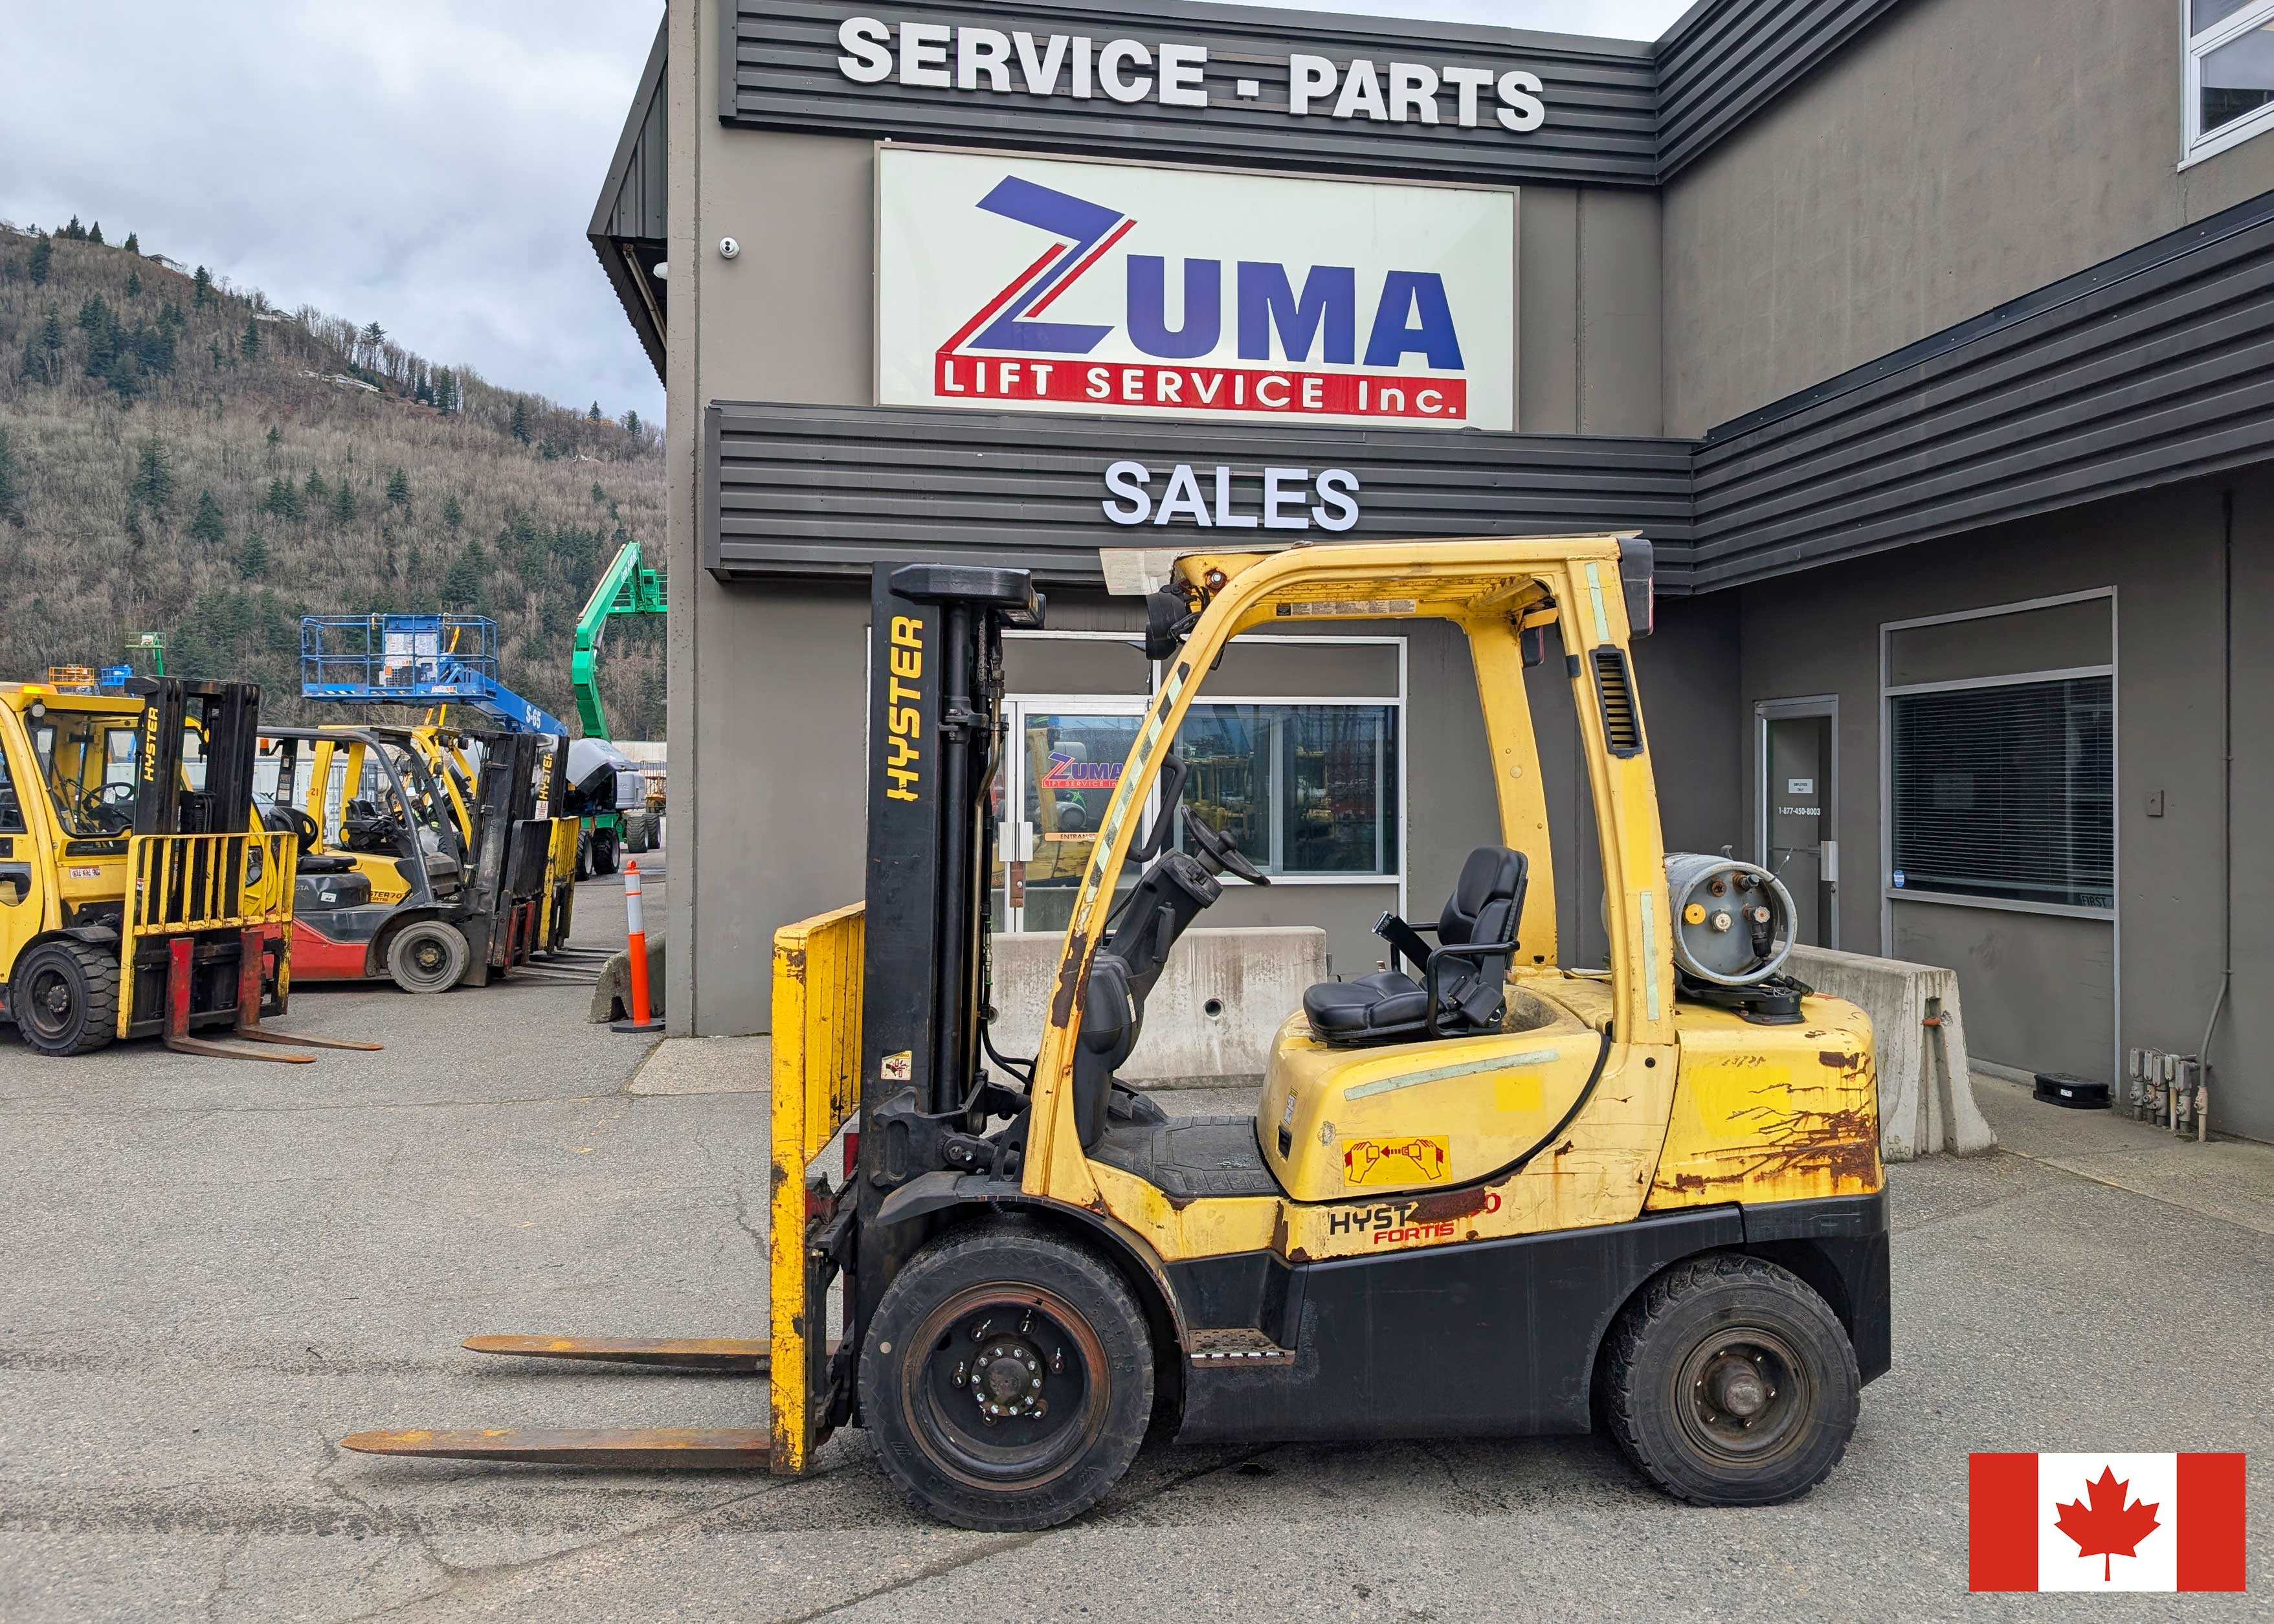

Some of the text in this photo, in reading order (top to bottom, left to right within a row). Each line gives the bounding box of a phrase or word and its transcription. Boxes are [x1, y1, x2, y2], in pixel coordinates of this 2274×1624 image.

[838, 17, 1209, 108] SERVICE
[1289, 54, 1546, 132] PARTS
[968, 175, 1465, 370] ZUMA
[944, 359, 1457, 416] LIFT SERVICE Inc.
[1102, 460, 1361, 531] SALES
[526, 704, 541, 729] S-65
[887, 615, 923, 802] HYSTER
[144, 707, 159, 781] HYSTER
[1047, 751, 1124, 781] ZUMA
[1778, 806, 1821, 816] 1-877-450-8003
[2081, 895, 2106, 907] FIRST
[1330, 1204, 1412, 1236] HYST
[1374, 1220, 1455, 1245] FORTIS
